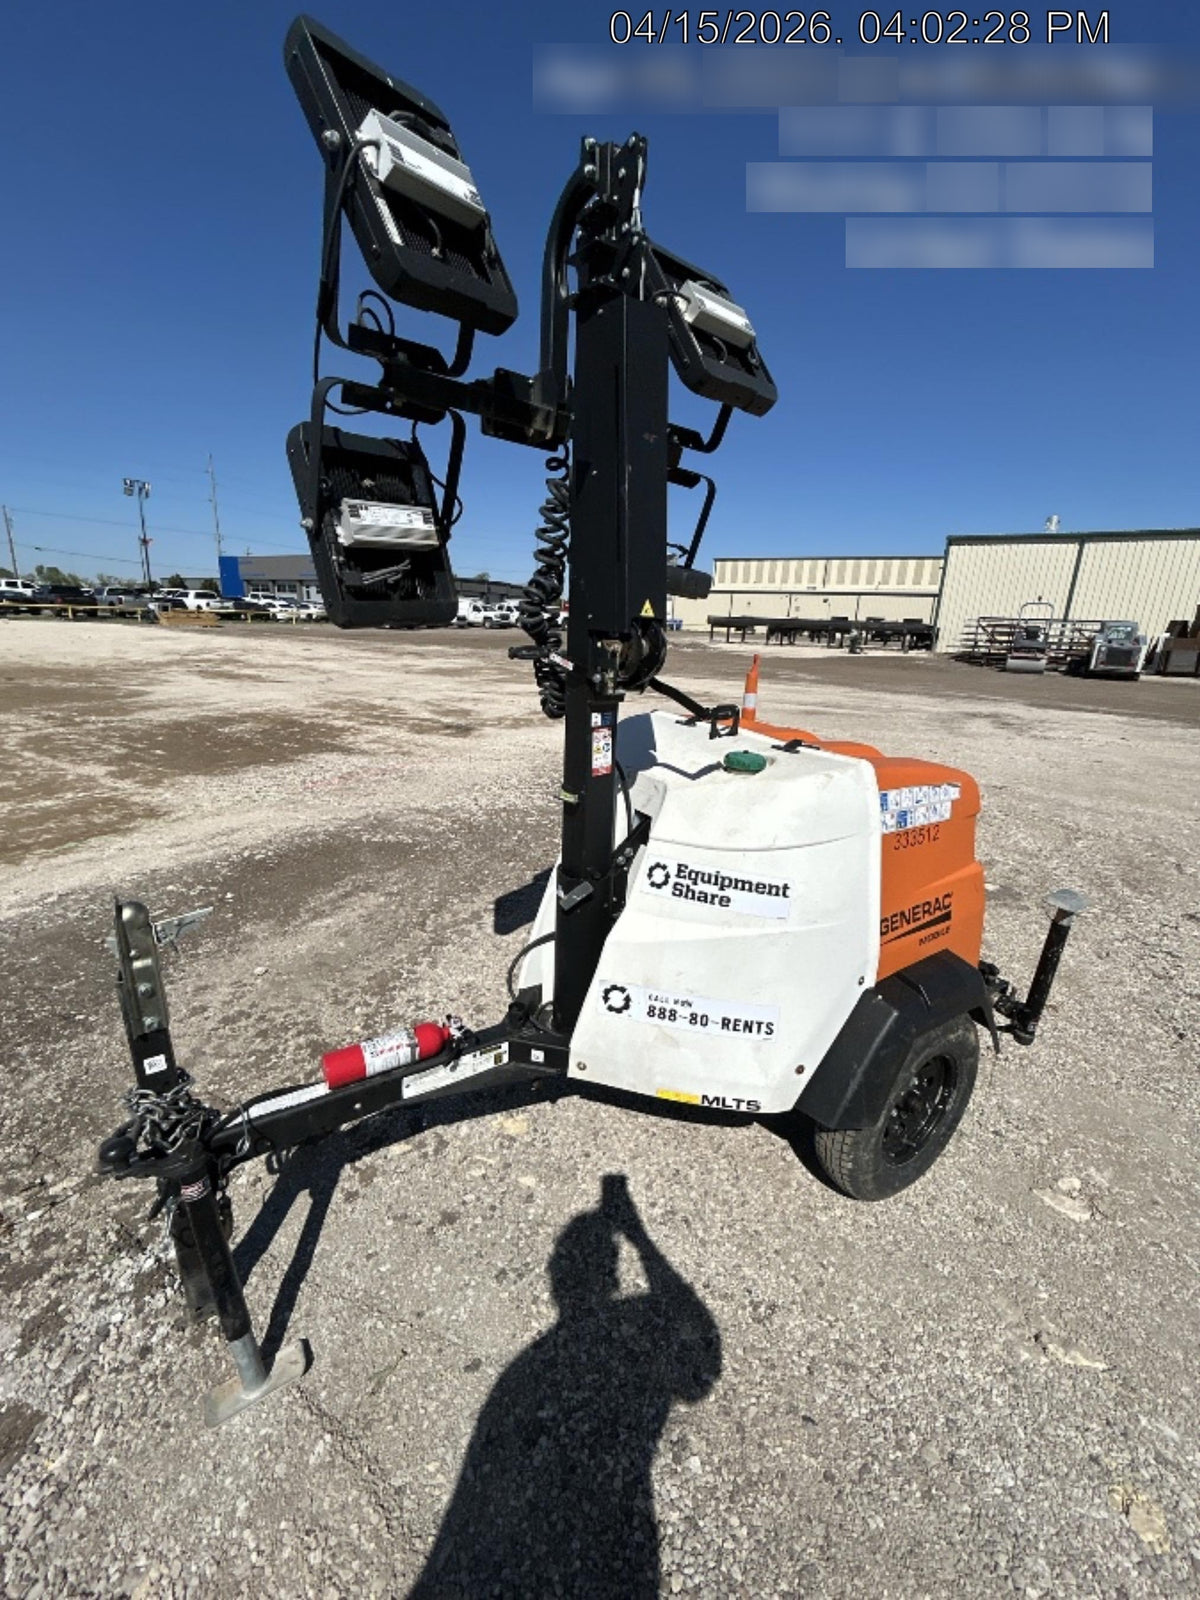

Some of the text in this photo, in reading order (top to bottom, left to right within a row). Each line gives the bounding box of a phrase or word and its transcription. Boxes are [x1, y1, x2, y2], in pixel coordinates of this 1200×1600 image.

[893, 824, 940, 851] 333512
[671, 881, 731, 907] Share
[675, 863, 790, 898] Equipment
[880, 891, 952, 936] GENERAC
[647, 1005, 775, 1035] 888-80-RENTS
[701, 1094, 762, 1112] MLTS
